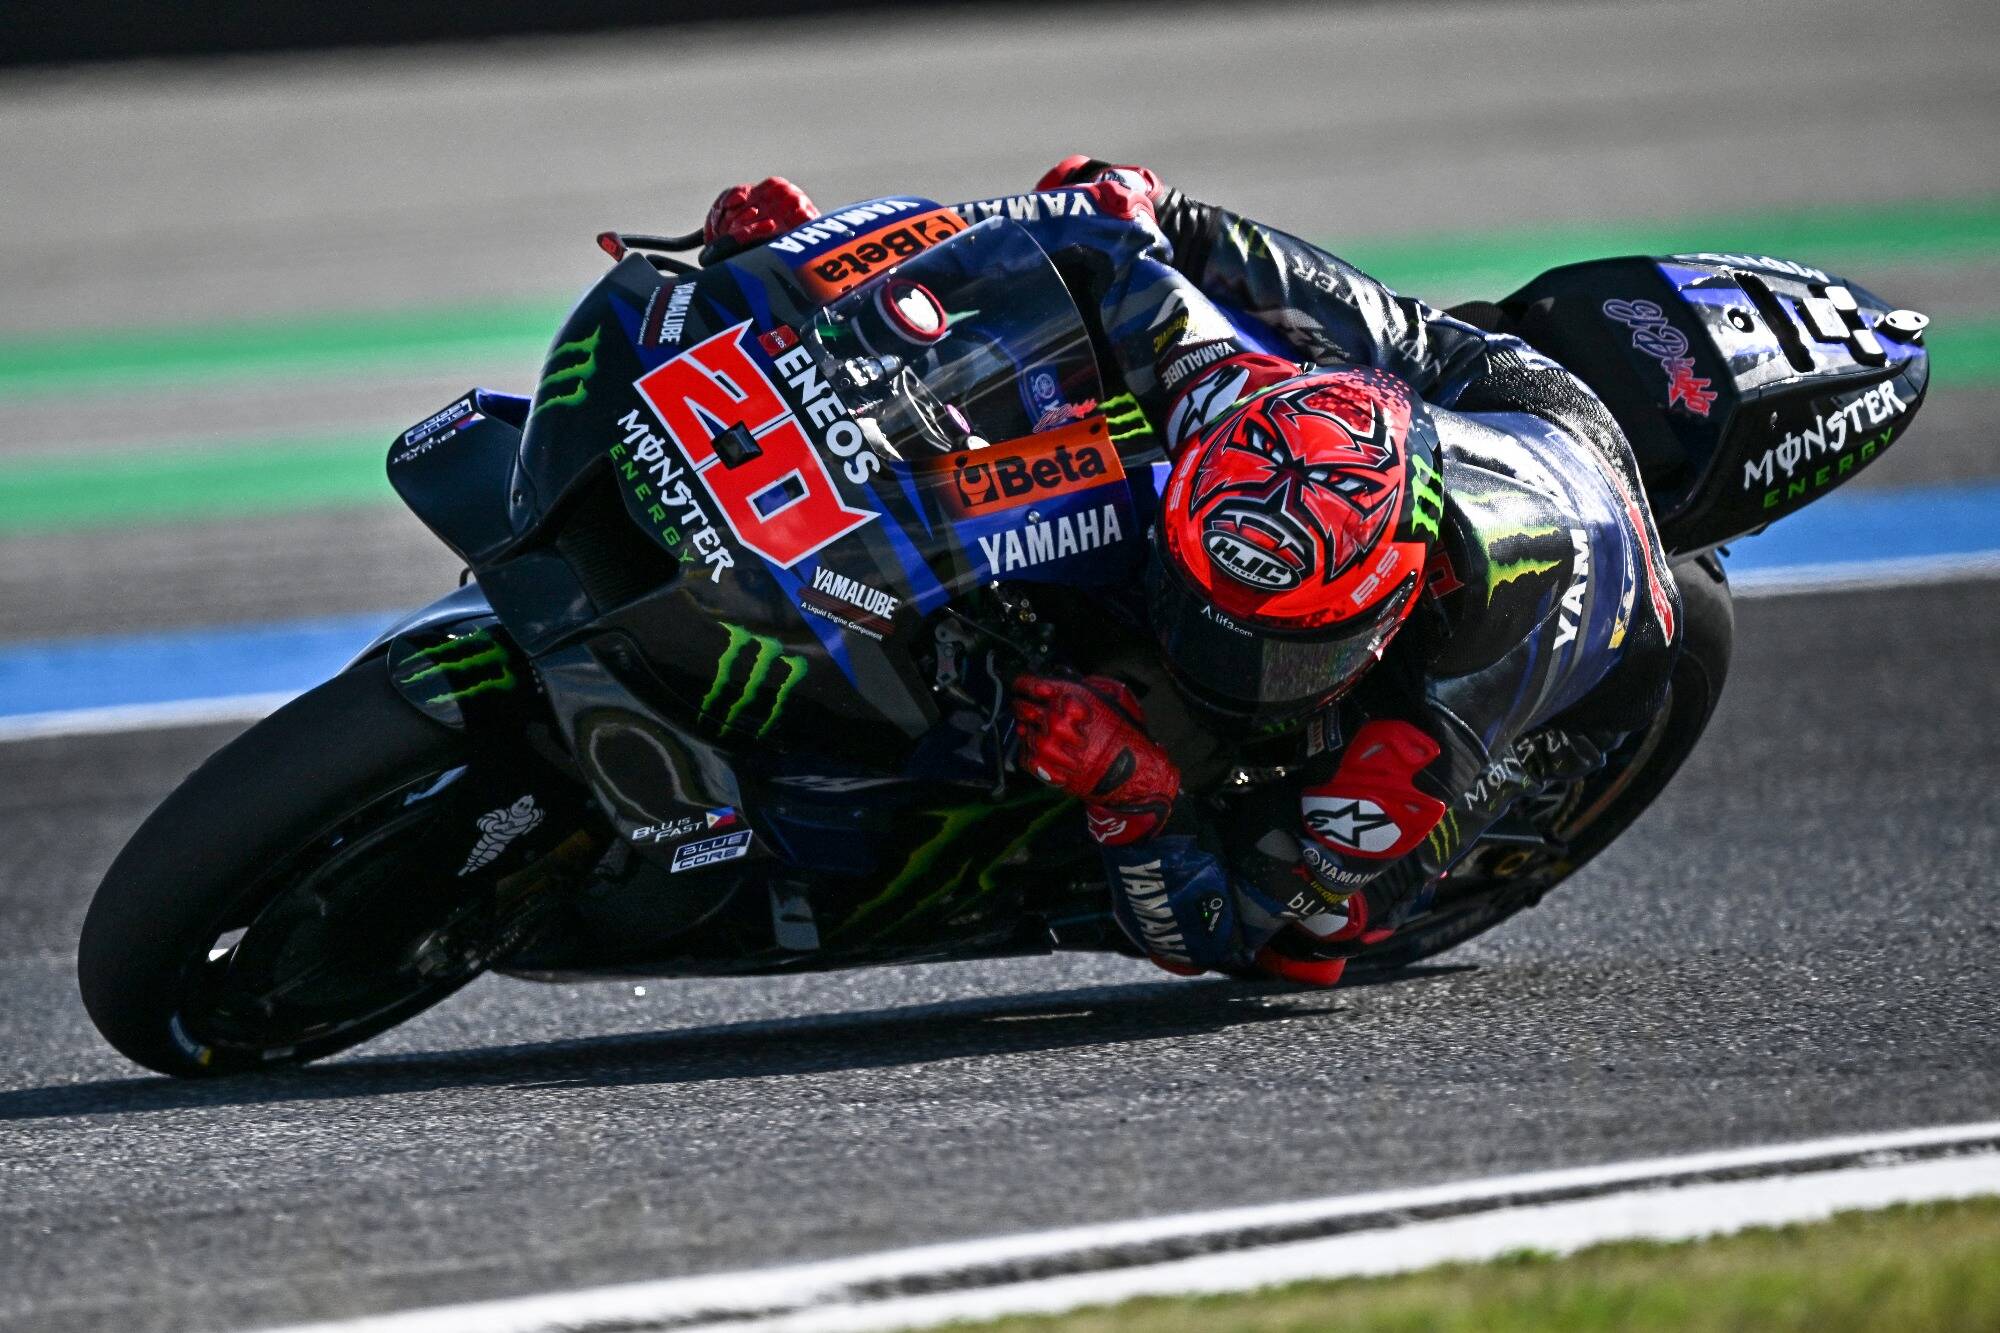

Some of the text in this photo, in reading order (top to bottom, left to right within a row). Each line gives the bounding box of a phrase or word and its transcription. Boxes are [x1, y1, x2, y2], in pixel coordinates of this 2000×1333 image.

[768, 200, 921, 254] YAMAHA
[815, 226, 925, 283] Beta
[658, 281, 697, 347] YAMALUBE
[1161, 341, 1236, 389] YAMALUBE
[773, 345, 881, 485] ENEOS
[633, 318, 882, 570] 20
[1763, 427, 1894, 509] ENERGY
[995, 445, 1107, 498] Beta
[609, 442, 695, 564] ENERGY
[978, 503, 1123, 575] YAMAHA
[1210, 536, 1290, 585] HJC
[808, 604, 827, 617] Liquid
[813, 565, 900, 621] YAMALUBE
[632, 816, 692, 840] BLU IS
[654, 821, 703, 843] FAST
[682, 834, 743, 857] BLUE
[678, 848, 740, 870] CORE
